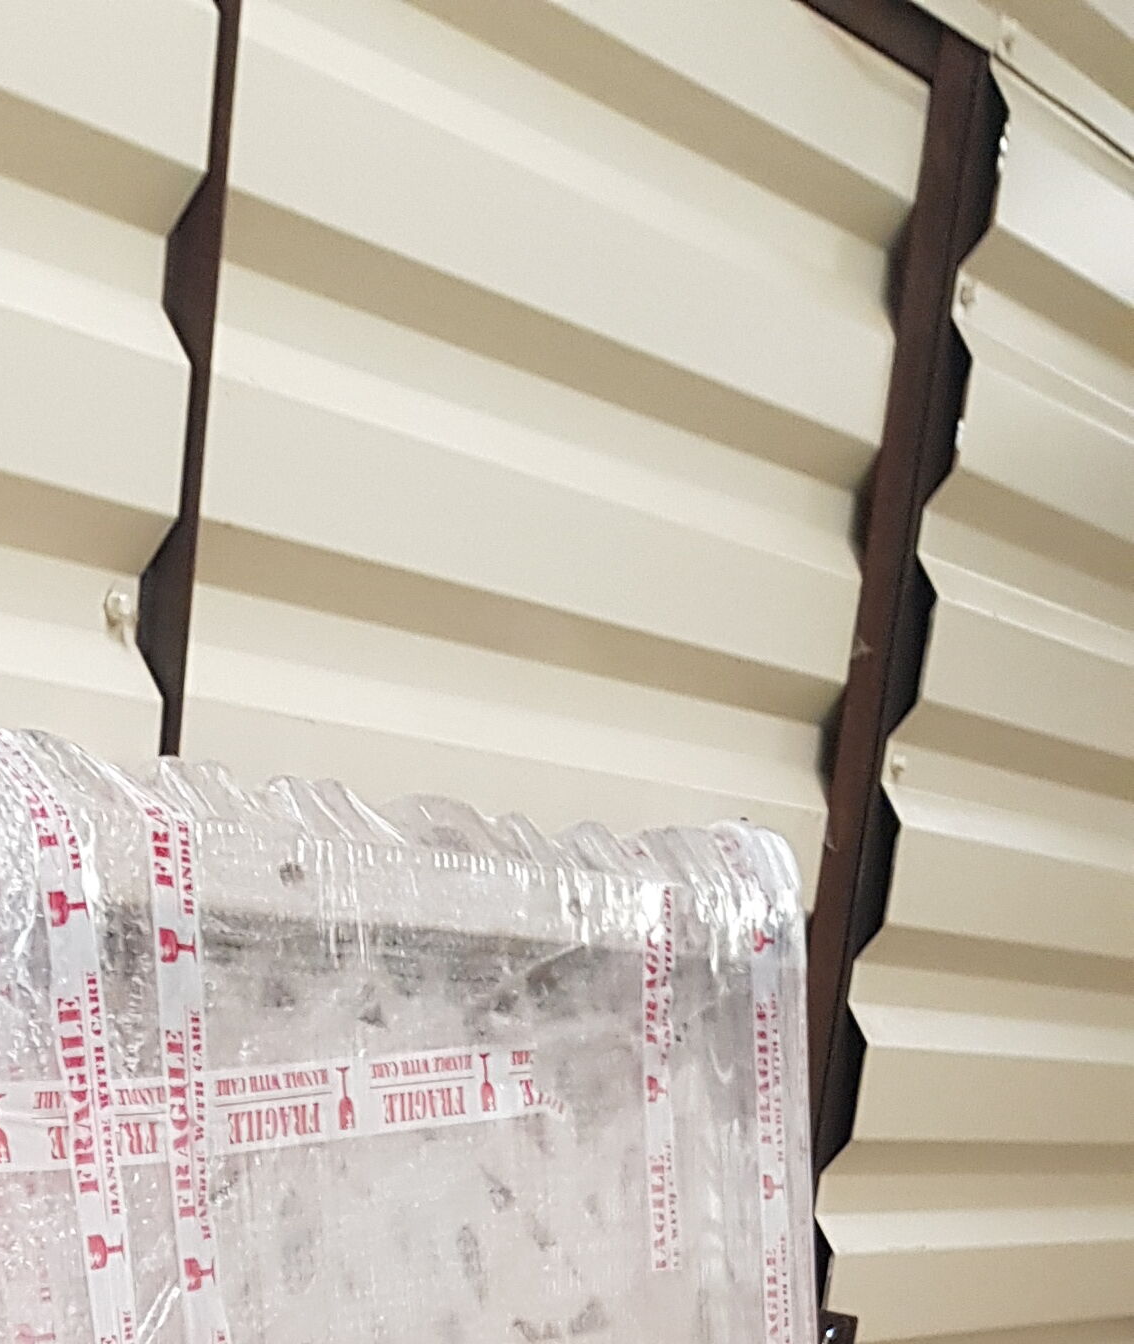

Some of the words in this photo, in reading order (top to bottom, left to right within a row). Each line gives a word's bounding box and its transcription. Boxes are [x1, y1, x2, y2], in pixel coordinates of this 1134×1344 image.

[57, 996, 102, 1194] FRAGILE
[166, 1029, 196, 1218] FRAGILE
[227, 1103, 320, 1144] FRAGILE
[383, 1086, 465, 1124] FRAGILE
